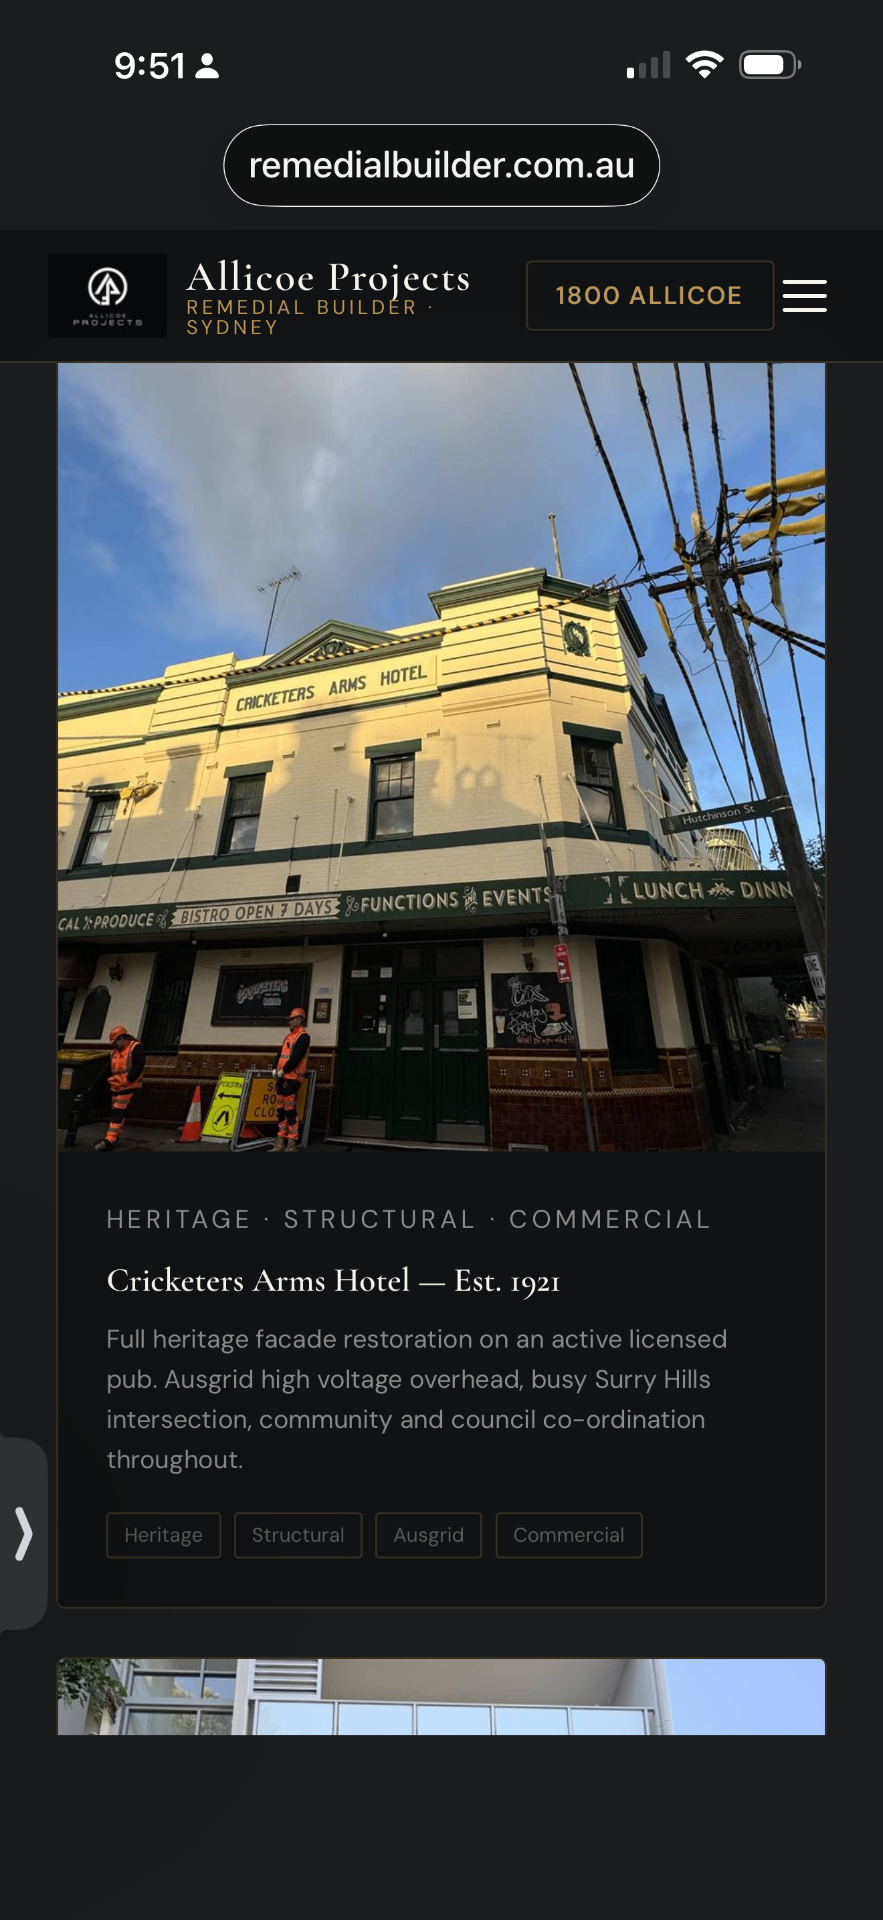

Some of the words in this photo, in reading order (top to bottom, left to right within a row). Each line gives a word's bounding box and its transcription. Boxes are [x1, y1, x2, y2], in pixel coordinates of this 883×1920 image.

[115, 52, 184, 79] 9:51
[250, 150, 634, 178] remedialbuilder.com.au
[186, 260, 316, 292] Allicoe
[327, 260, 470, 304] Projects
[555, 285, 620, 305] 1800
[628, 285, 742, 305] ALLICOE
[187, 300, 305, 315] REMEDIAL
[317, 300, 416, 315] BUILDER
[72, 319, 143, 327] PROJECTS
[187, 320, 277, 335] SYDNEY
[236, 685, 315, 712] CRICKETERS
[328, 675, 367, 696] ARMS
[380, 664, 428, 687] HOTEL
[683, 808, 741, 825] Hutchinson
[743, 804, 756, 814] St
[361, 891, 460, 913] FUNCTIONS
[482, 886, 552, 908] EVENTS
[633, 881, 705, 901] LUNCH
[94, 912, 155, 930] PRODUCE
[180, 907, 229, 924] BISTRO
[235, 904, 275, 920] OPEN
[280, 902, 289, 918] 7
[294, 899, 332, 916] DAYS
[220, 1081, 243, 1089] PEDESTRIA
[263, 1094, 277, 1105] RO
[106, 1209, 249, 1229] HERITAGE
[284, 1209, 475, 1229] STRUCTURAL
[509, 1209, 711, 1229] COMMERCIAL
[107, 1265, 244, 1292] Cricketers
[252, 1268, 326, 1292] Arms
[334, 1265, 410, 1292] Hotel
[454, 1268, 502, 1292] Est.
[510, 1276, 561, 1301] 1921
[107, 1328, 145, 1349] Full
[153, 1328, 249, 1355] heritage
[255, 1328, 337, 1349] facade
[344, 1328, 472, 1349] restoration
[479, 1333, 509, 1349] on
[516, 1333, 544, 1349] an
[551, 1328, 623, 1349] active
[629, 1328, 727, 1349] licensed
[107, 1368, 158, 1394] pub.
[164, 1368, 253, 1395] Ausgrid
[262, 1368, 310, 1395] high
[317, 1368, 402, 1395] voltage
[410, 1368, 524, 1392] overhead,
[532, 1368, 588, 1394] busy
[595, 1369, 657, 1394] Surry
[664, 1368, 711, 1389] Hills
[107, 1408, 252, 1432] intersection,
[259, 1408, 393, 1435] community
[400, 1409, 443, 1429] and
[451, 1408, 536, 1429] council
[543, 1408, 705, 1429] co-ordination
[106, 1449, 243, 1475] throughout.
[124, 1526, 203, 1547] Heritage
[252, 1526, 344, 1543] Structural
[393, 1526, 464, 1548] Ausgrid
[513, 1526, 624, 1543] Commercial
